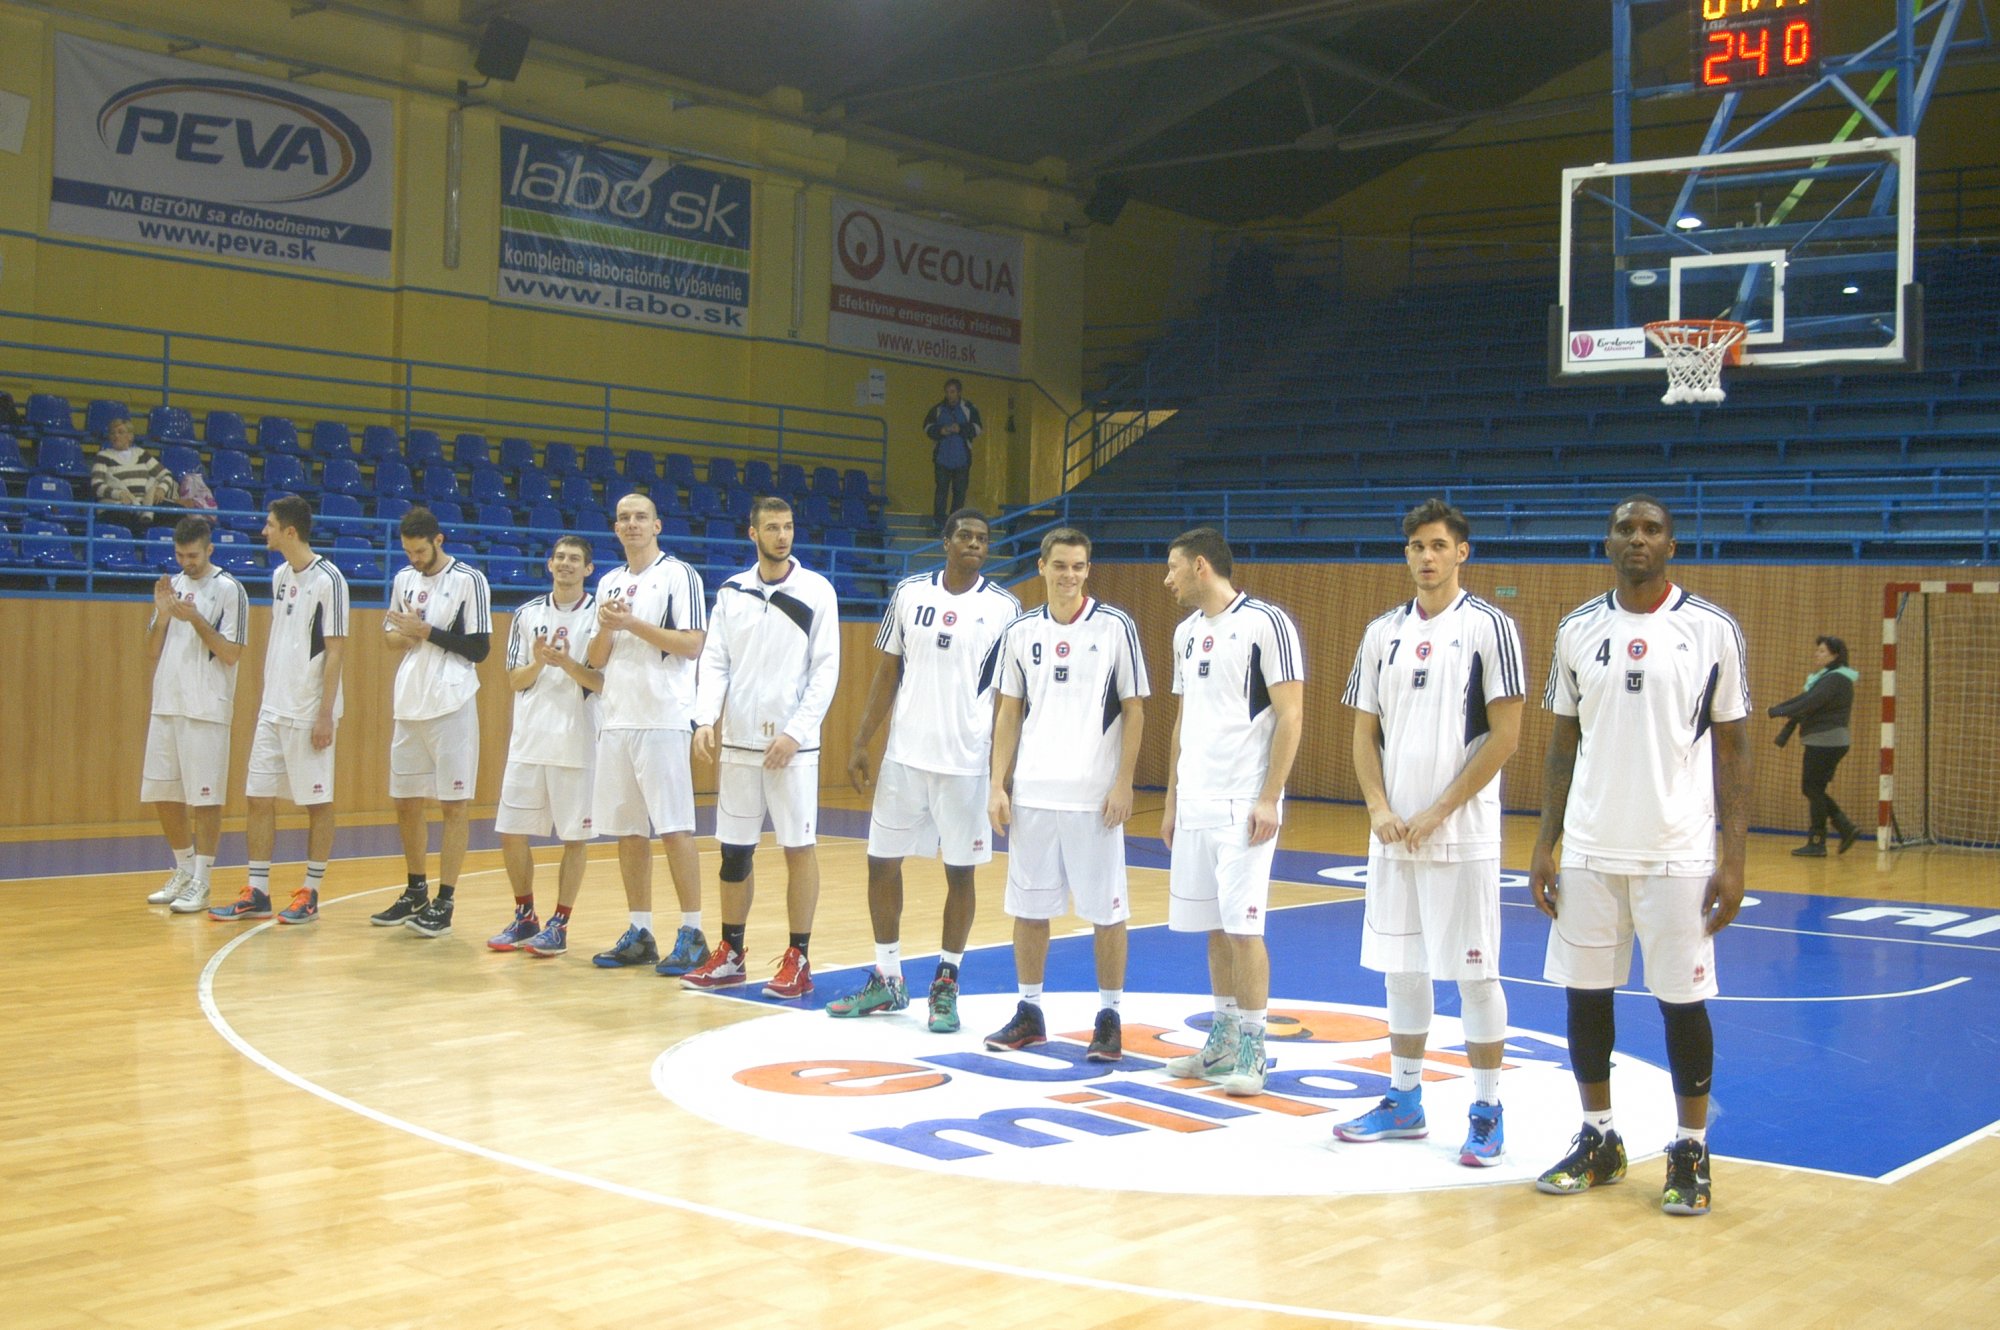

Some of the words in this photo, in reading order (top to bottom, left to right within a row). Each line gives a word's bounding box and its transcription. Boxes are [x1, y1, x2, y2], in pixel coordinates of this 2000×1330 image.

[1703, 29, 1769, 85] 24
[116, 106, 329, 175] PEVA
[107, 191, 135, 210] NA
[206, 208, 227, 223] sa
[231, 210, 330, 239] dohodneme
[665, 184, 739, 237] sk
[138, 220, 316, 261] www.peva.sk
[504, 243, 585, 275] kompletné
[588, 257, 671, 290] laboratórne
[674, 272, 743, 301] vybavenie
[893, 239, 1015, 297] VEOLIA
[504, 276, 743, 327] www.labo.sk
[838, 293, 896, 316] Efektívne
[876, 331, 977, 364] www.veolia.sk
[914, 605, 936, 627] 10
[1032, 642, 1042, 665] 9
[1185, 637, 1195, 659] 8
[1388, 639, 1401, 666] 7
[1595, 638, 1611, 667] 4
[762, 721, 775, 736] 11
